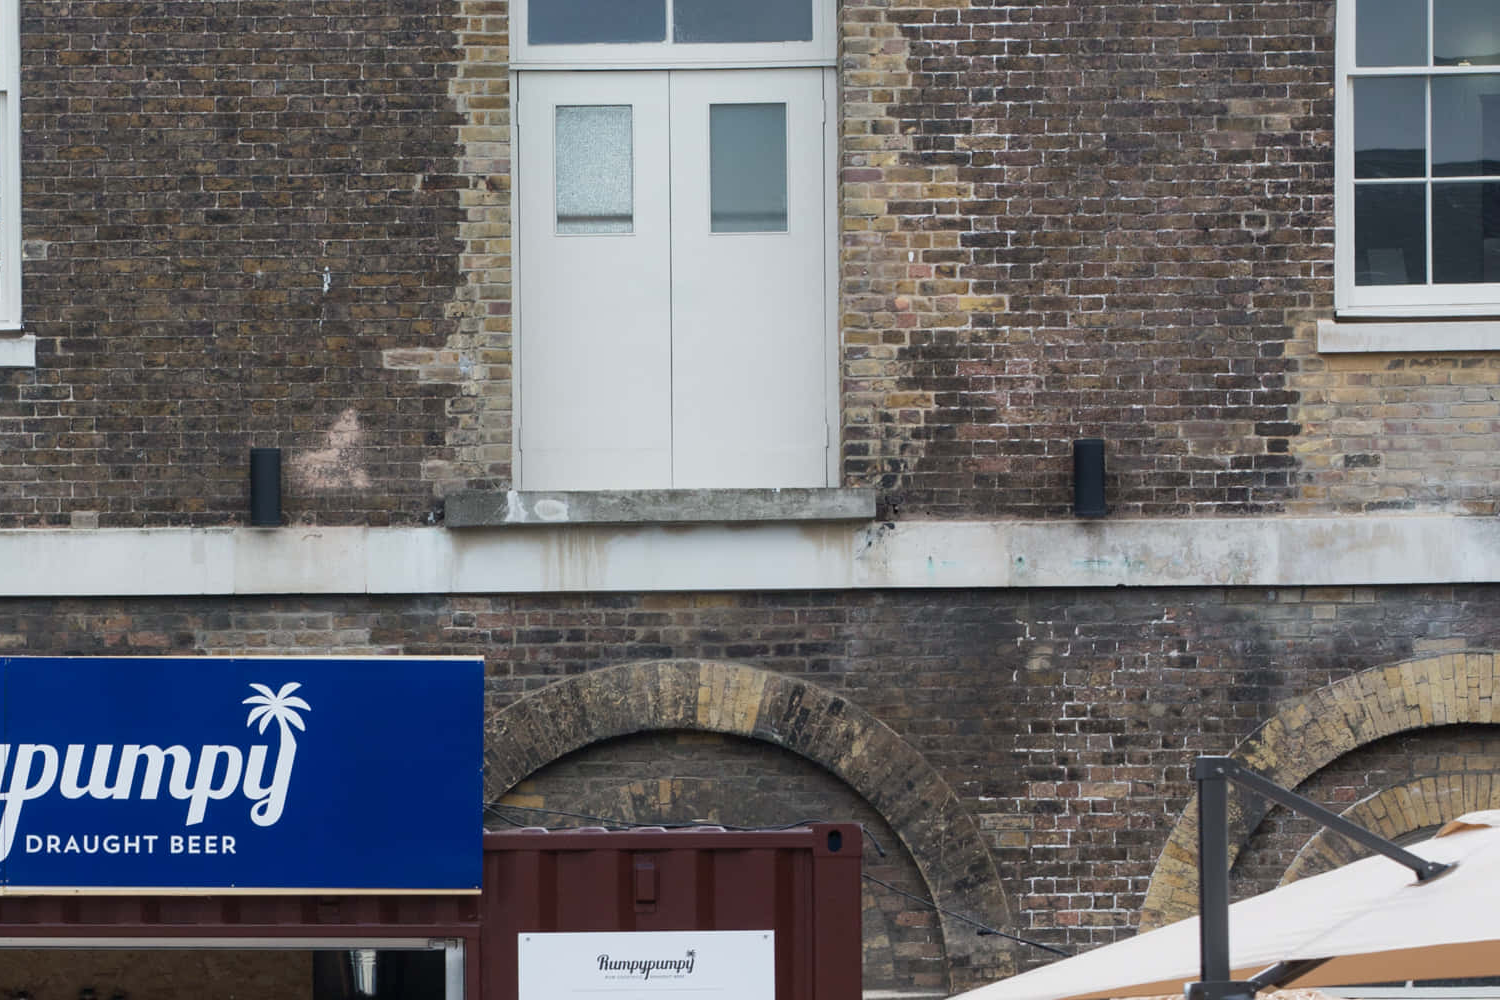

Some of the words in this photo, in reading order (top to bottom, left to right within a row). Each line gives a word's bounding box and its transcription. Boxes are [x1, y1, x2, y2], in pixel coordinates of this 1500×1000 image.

[25, 834, 159, 854] DRAUGHT
[170, 834, 237, 854] BEER
[596, 949, 697, 980] Rumpypumpy
